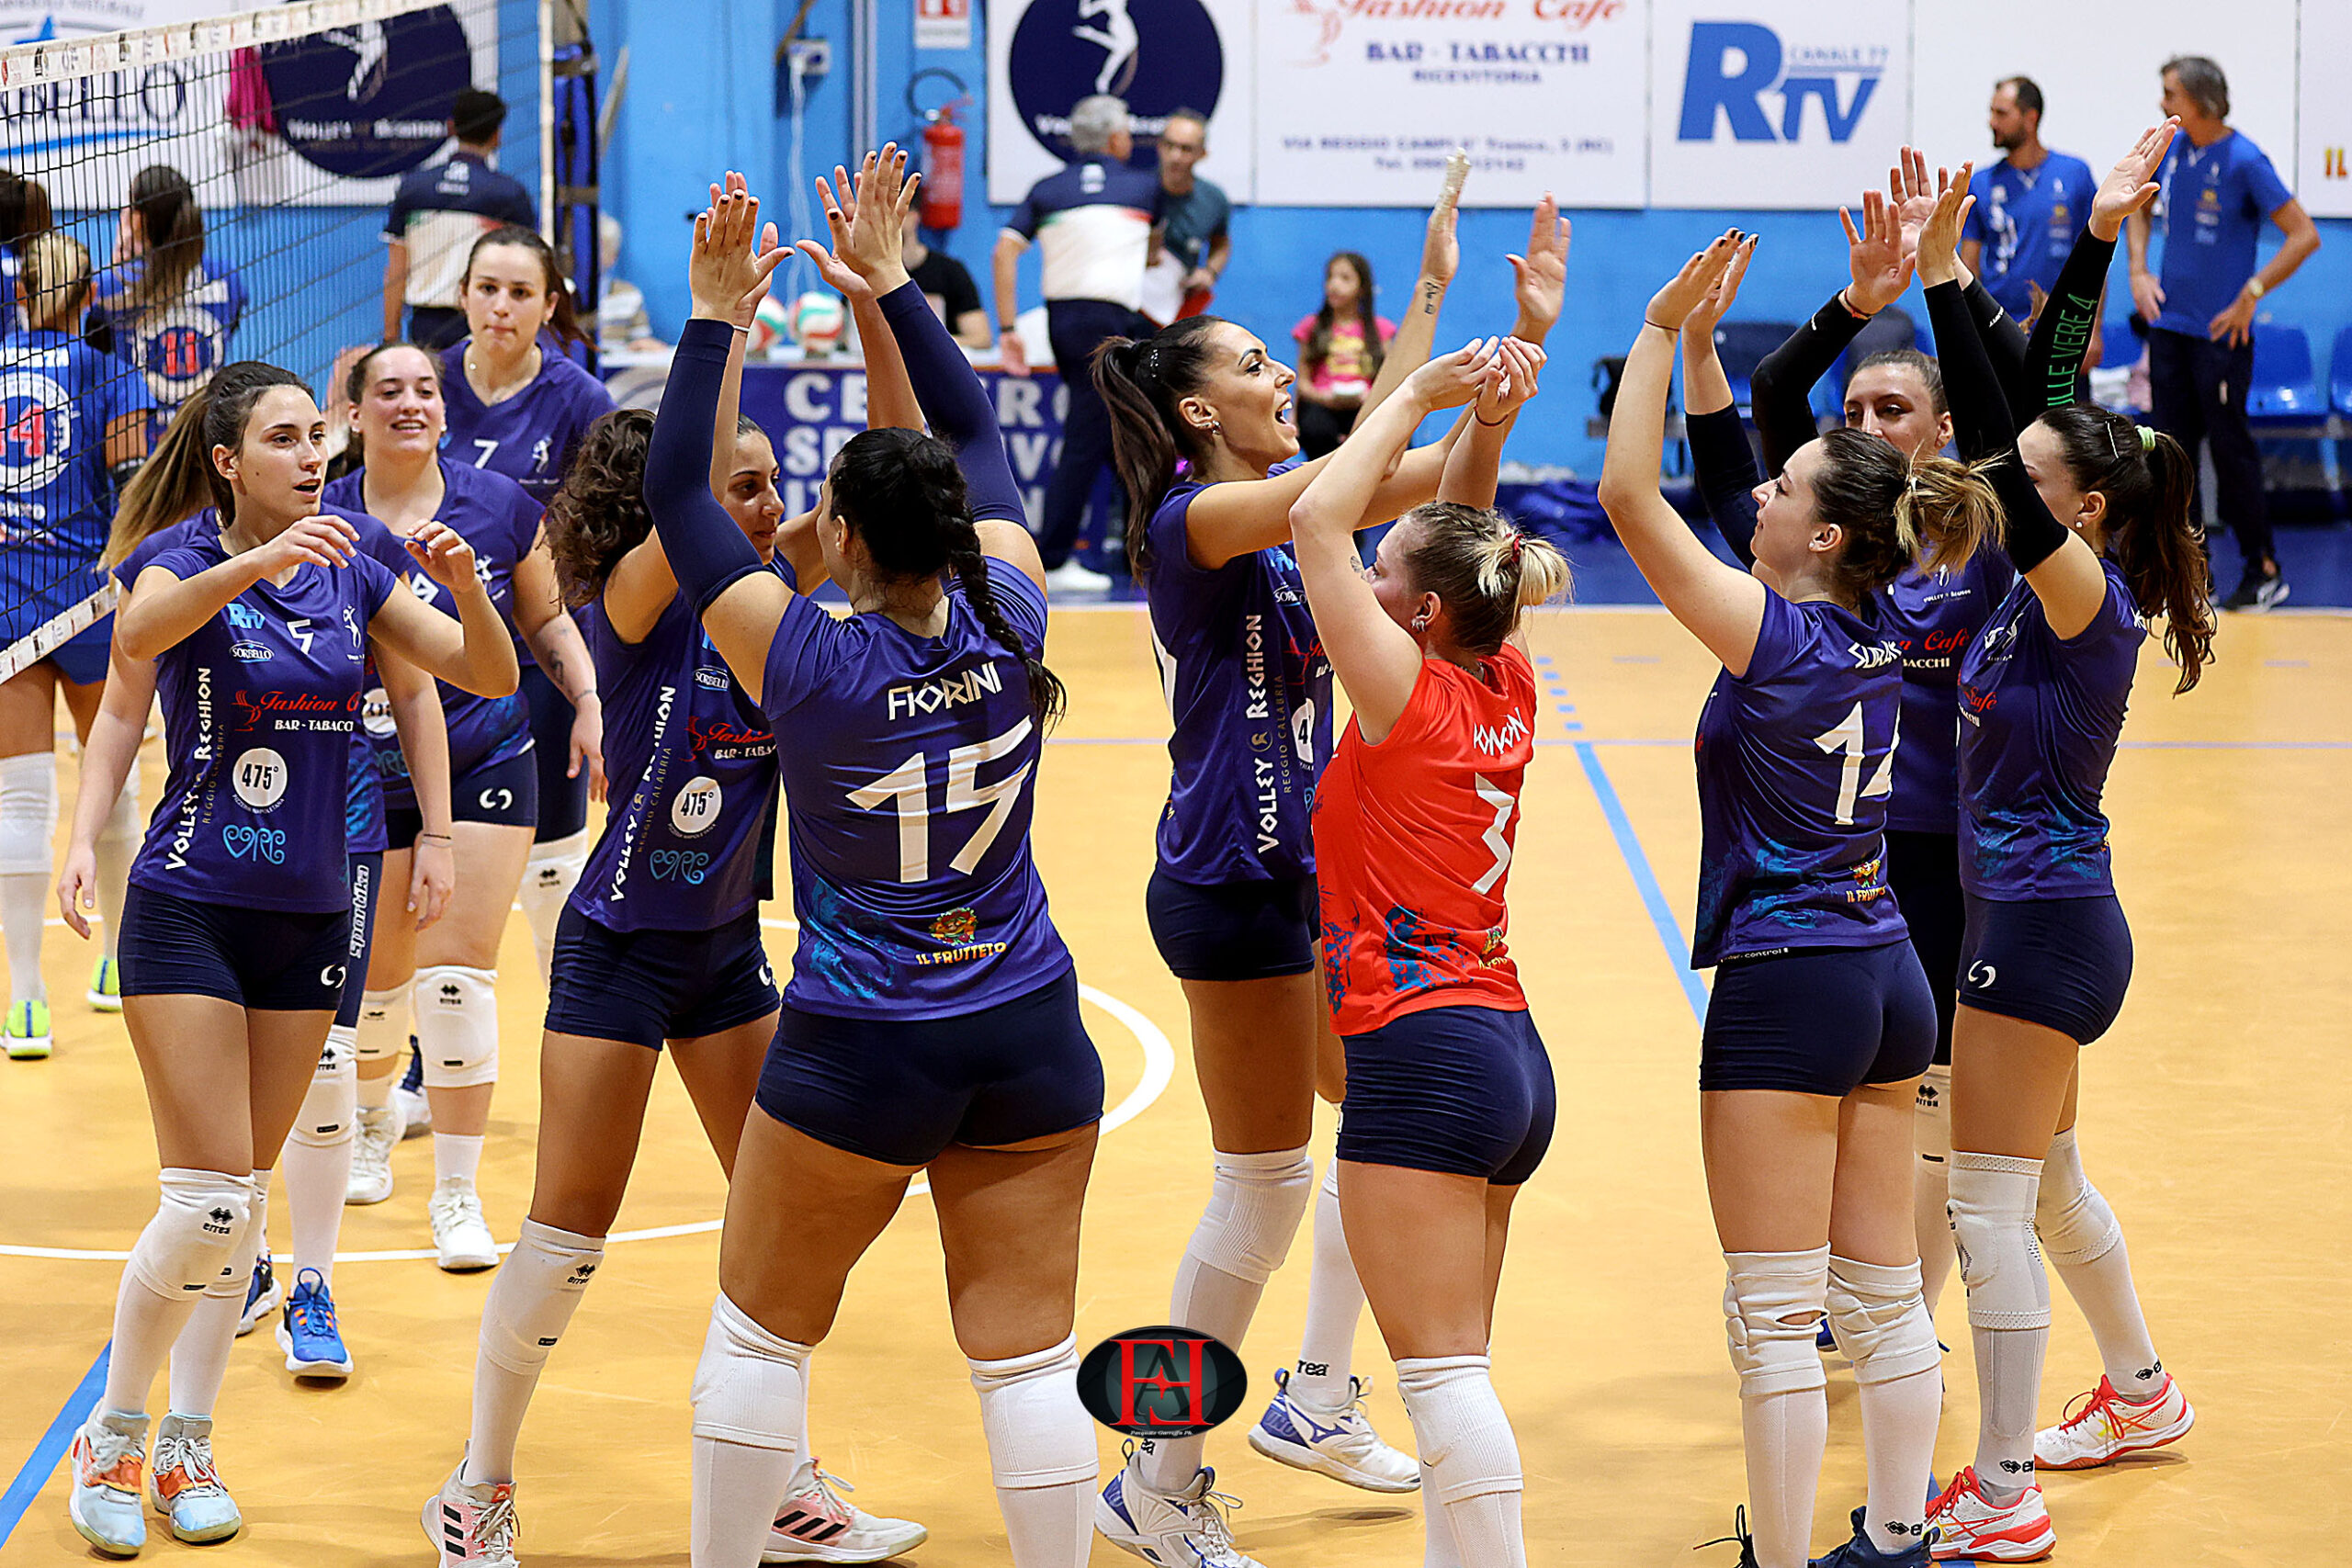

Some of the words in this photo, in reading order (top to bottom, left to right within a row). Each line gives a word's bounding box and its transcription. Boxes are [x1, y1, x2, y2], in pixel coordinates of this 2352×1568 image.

[1449, 42, 1589, 62] TABACCHI
[2324, 147, 2348, 176] IL
[2051, 309, 2093, 358] VERE
[473, 438, 499, 469] 7
[287, 618, 314, 656] 5
[1246, 615, 1270, 719] REGHION
[1902, 658, 1951, 668] BACCHI
[194, 667, 212, 761] REGHION
[259, 691, 338, 713] Fashion
[888, 661, 1003, 721] FIORINI
[1273, 675, 1286, 739] CALABRIA
[274, 719, 300, 731] BAR
[1279, 745, 1292, 794] REGGIO
[202, 780, 218, 824] REGGIO
[845, 715, 1034, 884] 15
[1253, 757, 1280, 854] VOLLEY
[164, 791, 199, 870] VOLLEY
[1471, 772, 1516, 896] 3
[610, 814, 639, 902] VOLLEY
[916, 953, 932, 965] IL
[932, 942, 1007, 965] FRUTTETO
